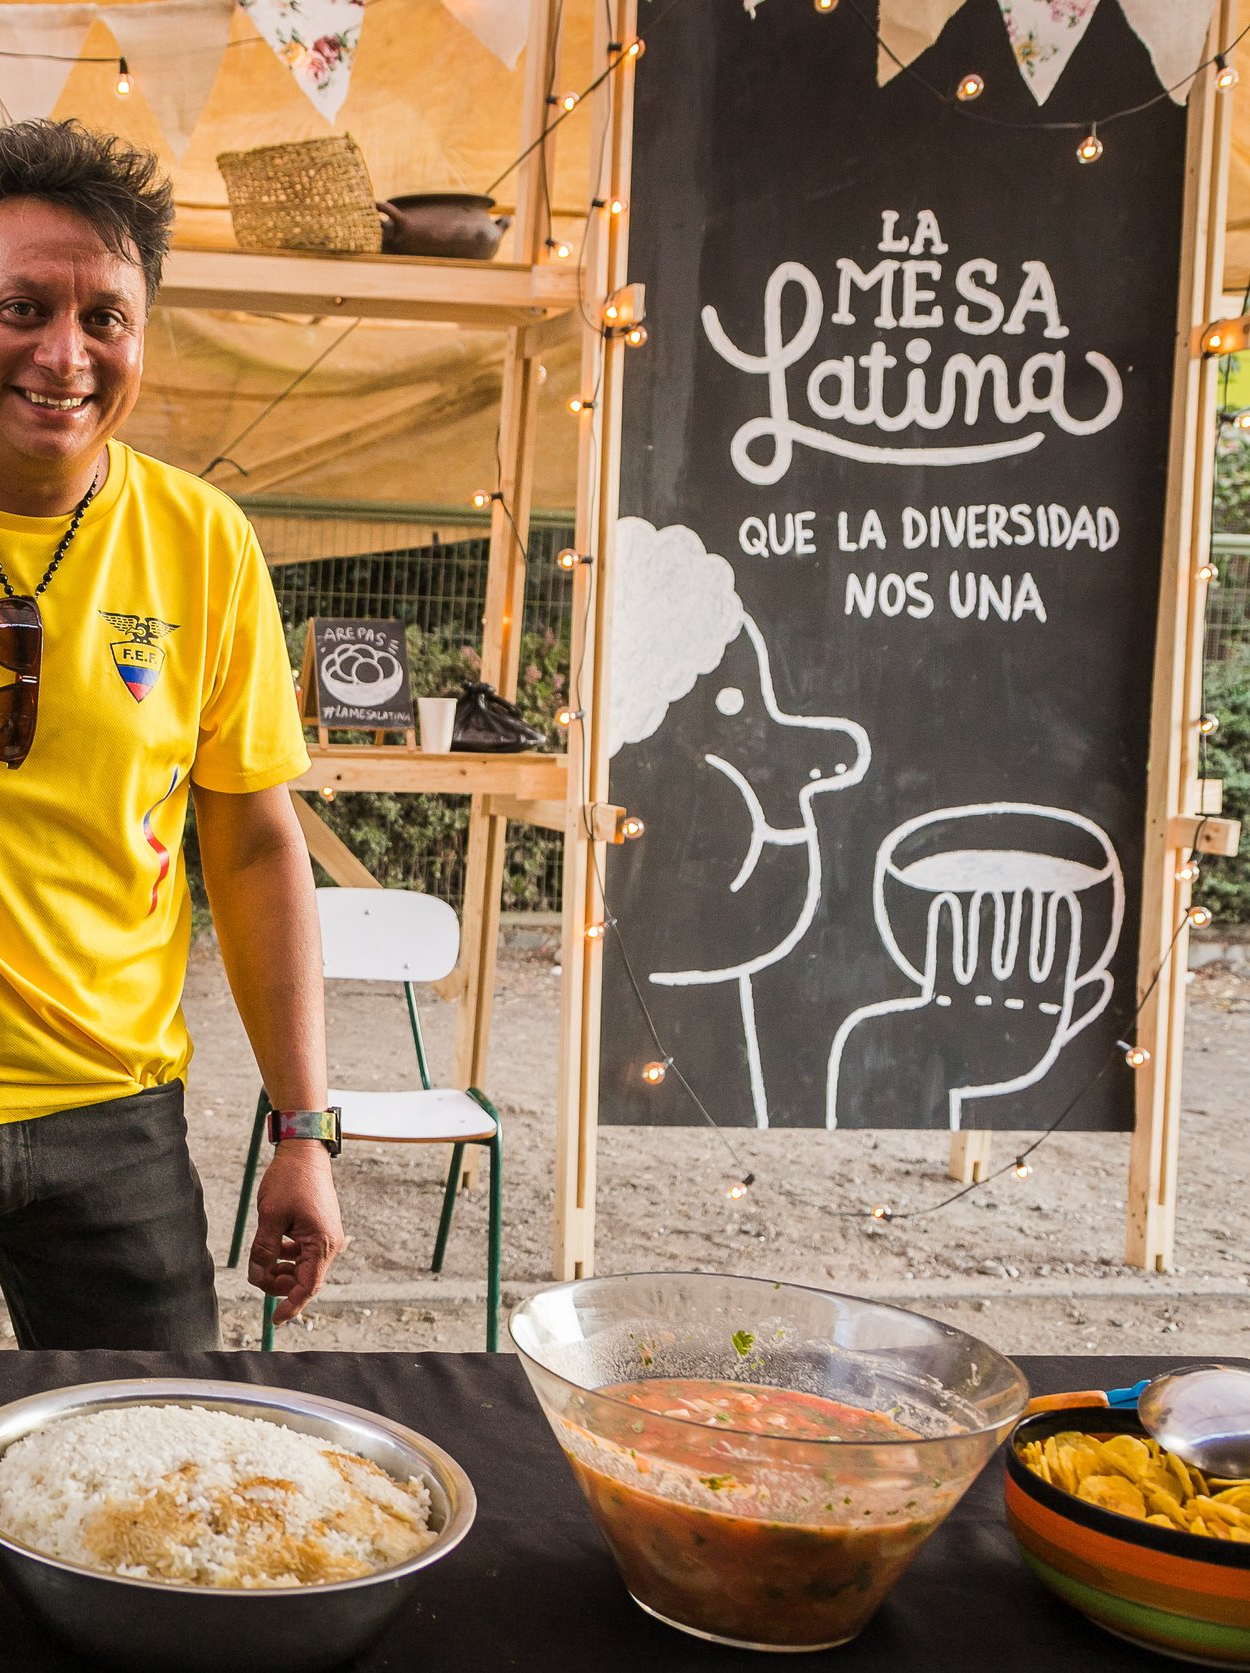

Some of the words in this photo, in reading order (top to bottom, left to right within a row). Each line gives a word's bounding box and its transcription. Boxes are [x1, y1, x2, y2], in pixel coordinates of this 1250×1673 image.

[877, 209, 949, 255] LA
[831, 257, 1069, 338] MESA
[701, 261, 1123, 486] Latina
[738, 510, 817, 557] QUE
[837, 508, 887, 551] LA
[902, 503, 1120, 552] DIVERSIDAD
[844, 571, 934, 619] NOS
[949, 571, 1048, 623] UNA
[123, 648, 157, 664] F.E.F.
[322, 704, 412, 722] #LAMESALATINA
